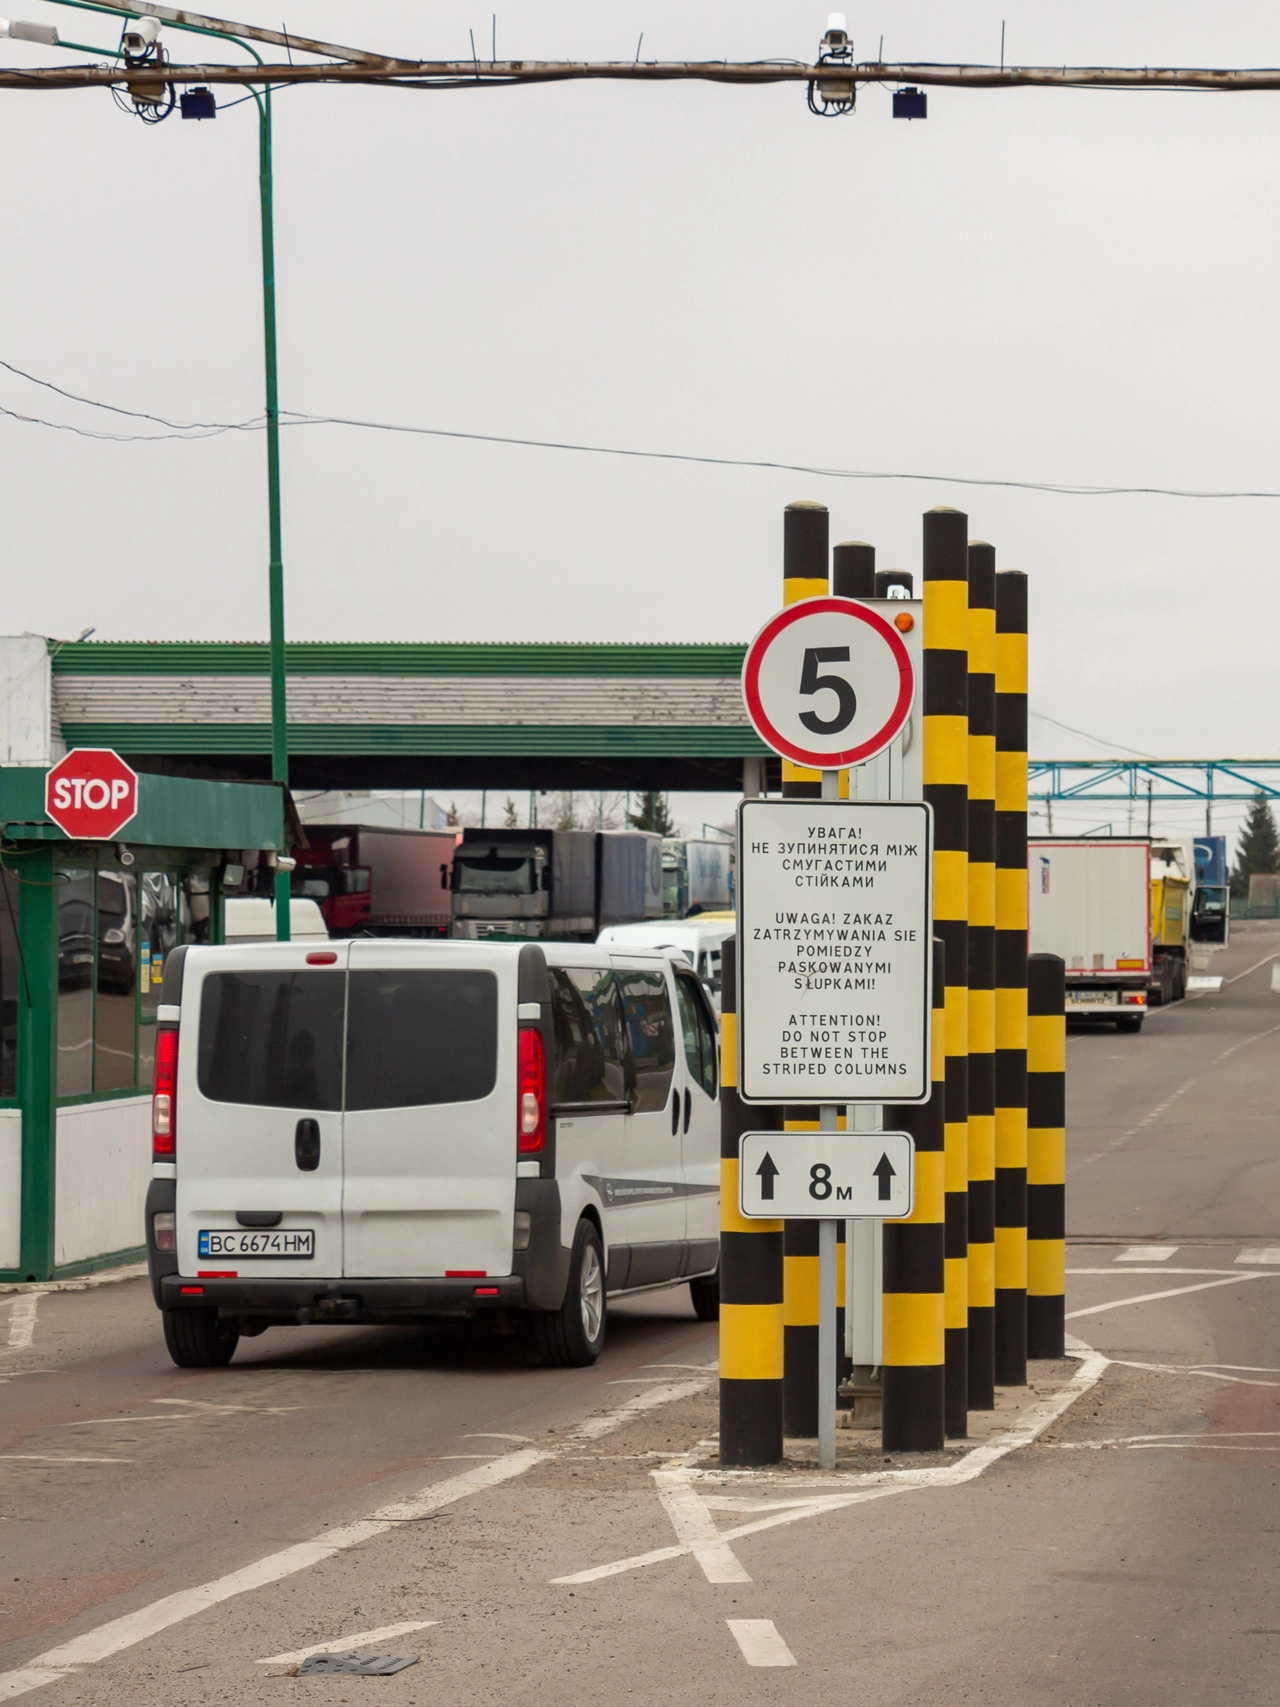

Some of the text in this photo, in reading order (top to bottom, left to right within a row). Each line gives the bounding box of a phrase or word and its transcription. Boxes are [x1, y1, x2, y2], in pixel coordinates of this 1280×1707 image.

[798, 646, 857, 735] 5
[54, 778, 129, 810] STOP
[807, 826, 862, 839] УВАГА!
[751, 842, 918, 856] НЕ ЗУПИНЯТИСЯ МІЖ
[782, 858, 887, 872] СМУГАСТИМИ
[795, 873, 874, 888] СТІЙКАМИ
[775, 912, 893, 926] UWAGA! ZAKAZ
[753, 928, 917, 942] ZATRZYMYWANIA SIE
[778, 961, 891, 975] PASKOWANYMI
[788, 1014, 880, 1027] ATTENTION!
[782, 1030, 887, 1043] DO NOT STOP
[780, 1046, 889, 1059] BETWEEN THE
[762, 1063, 907, 1075] STRIPED COLUMNS
[239, 1234, 281, 1252] 6674
[284, 1234, 311, 1252] HM
